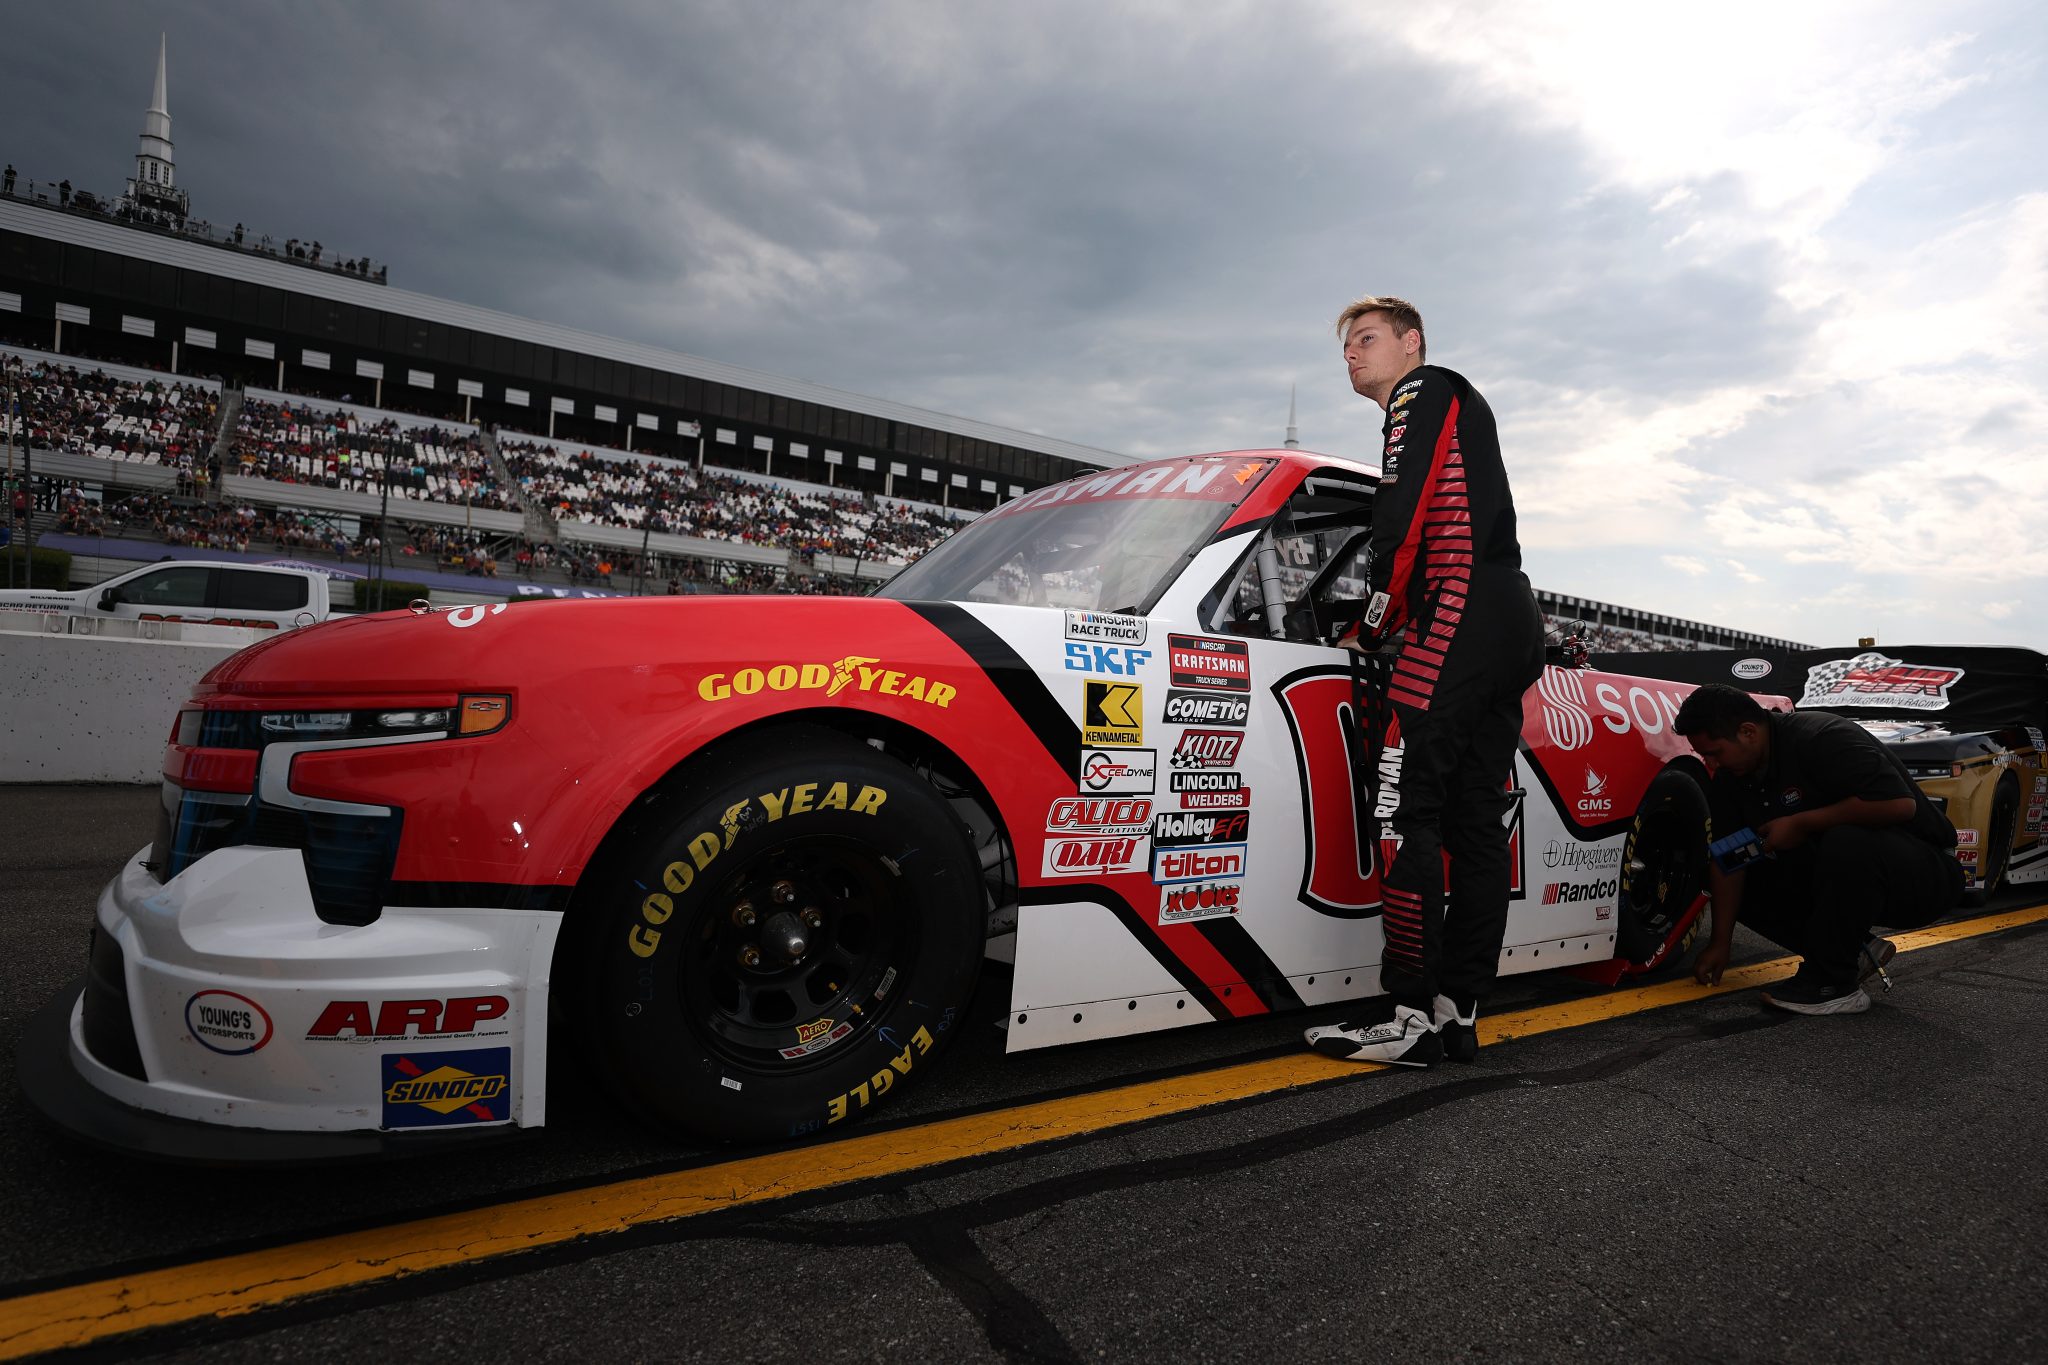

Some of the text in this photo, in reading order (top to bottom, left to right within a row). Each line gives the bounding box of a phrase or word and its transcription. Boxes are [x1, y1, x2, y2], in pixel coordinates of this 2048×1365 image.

[1091, 613, 1136, 627] NASCAR
[1071, 623, 1139, 639] RACE TRUCK
[1201, 641, 1226, 652] NASCAR
[1065, 643, 1152, 676] SKF
[1174, 653, 1245, 673] CRAFTSMAN
[1195, 675, 1228, 686] TRUCK SERIES
[1167, 699, 1247, 721] COMETIC
[1905, 698, 1945, 709] RACING
[1086, 731, 1140, 744] KENNAMETAL
[1182, 733, 1240, 760] KLOTZ
[1173, 774, 1238, 790] LINCOLN
[1187, 794, 1243, 807] WELDERS
[1577, 798, 1612, 811] GMS
[1051, 799, 1152, 828] CALICO
[1156, 814, 1215, 842] Holley
[1056, 836, 1144, 868] DART
[1161, 853, 1240, 878] tilton
[1166, 883, 1241, 913] KOOKS
[1557, 878, 1617, 904] Randco
[199, 1005, 252, 1030] YOUNG'S
[306, 995, 510, 1037] ARP
[197, 1024, 256, 1041] MOTORSPORTS
[373, 1035, 408, 1043] products
[803, 1021, 828, 1038] AERO
[1359, 1028, 1392, 1041] sparco
[828, 1025, 935, 1126] EAGLE
[390, 1076, 503, 1102] SUNOCO
